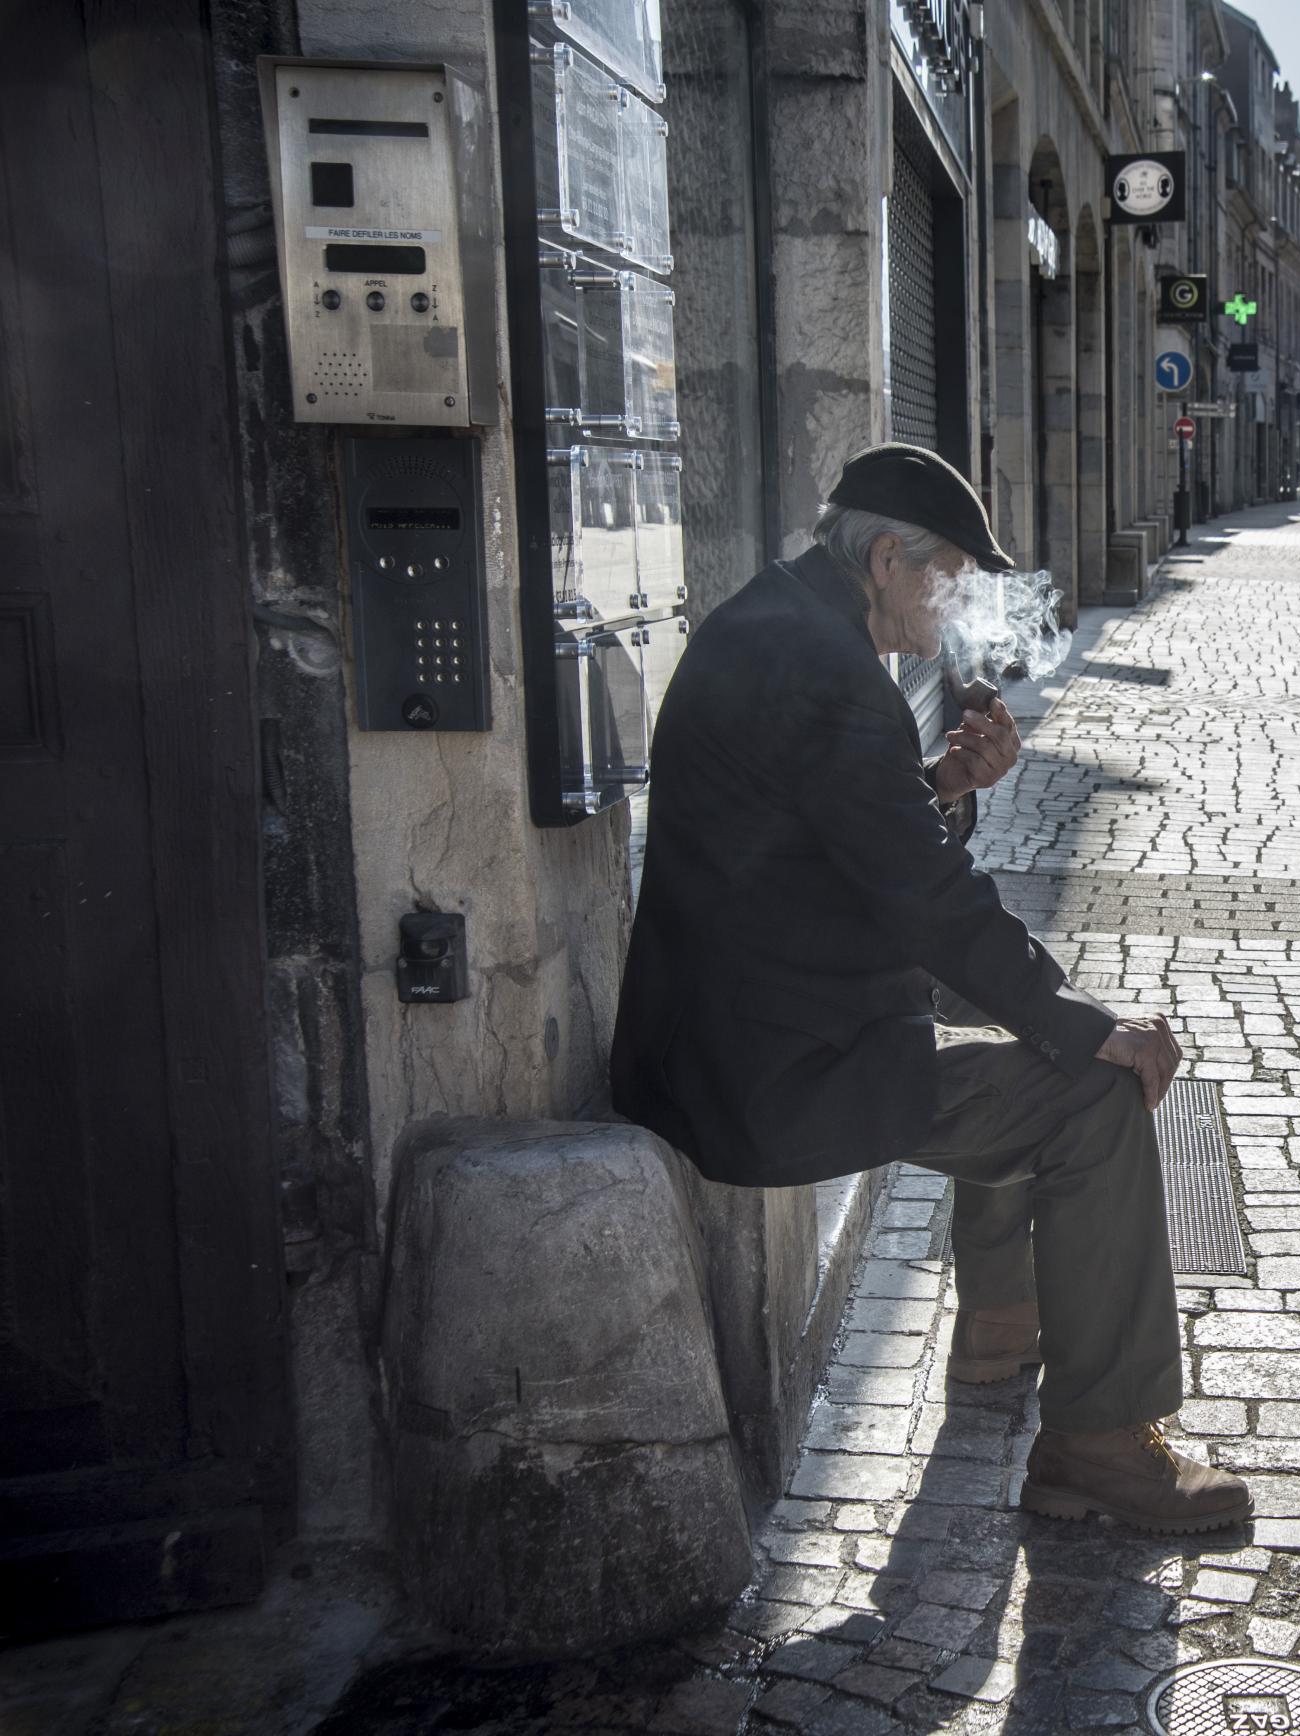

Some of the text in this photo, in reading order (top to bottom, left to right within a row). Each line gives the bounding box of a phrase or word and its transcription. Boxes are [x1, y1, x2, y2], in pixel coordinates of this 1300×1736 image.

[328, 229, 423, 240] FAIRE DEFILER LES NOMS
[364, 280, 388, 288] APPEL
[1229, 1714, 1291, 1730] GAZ
